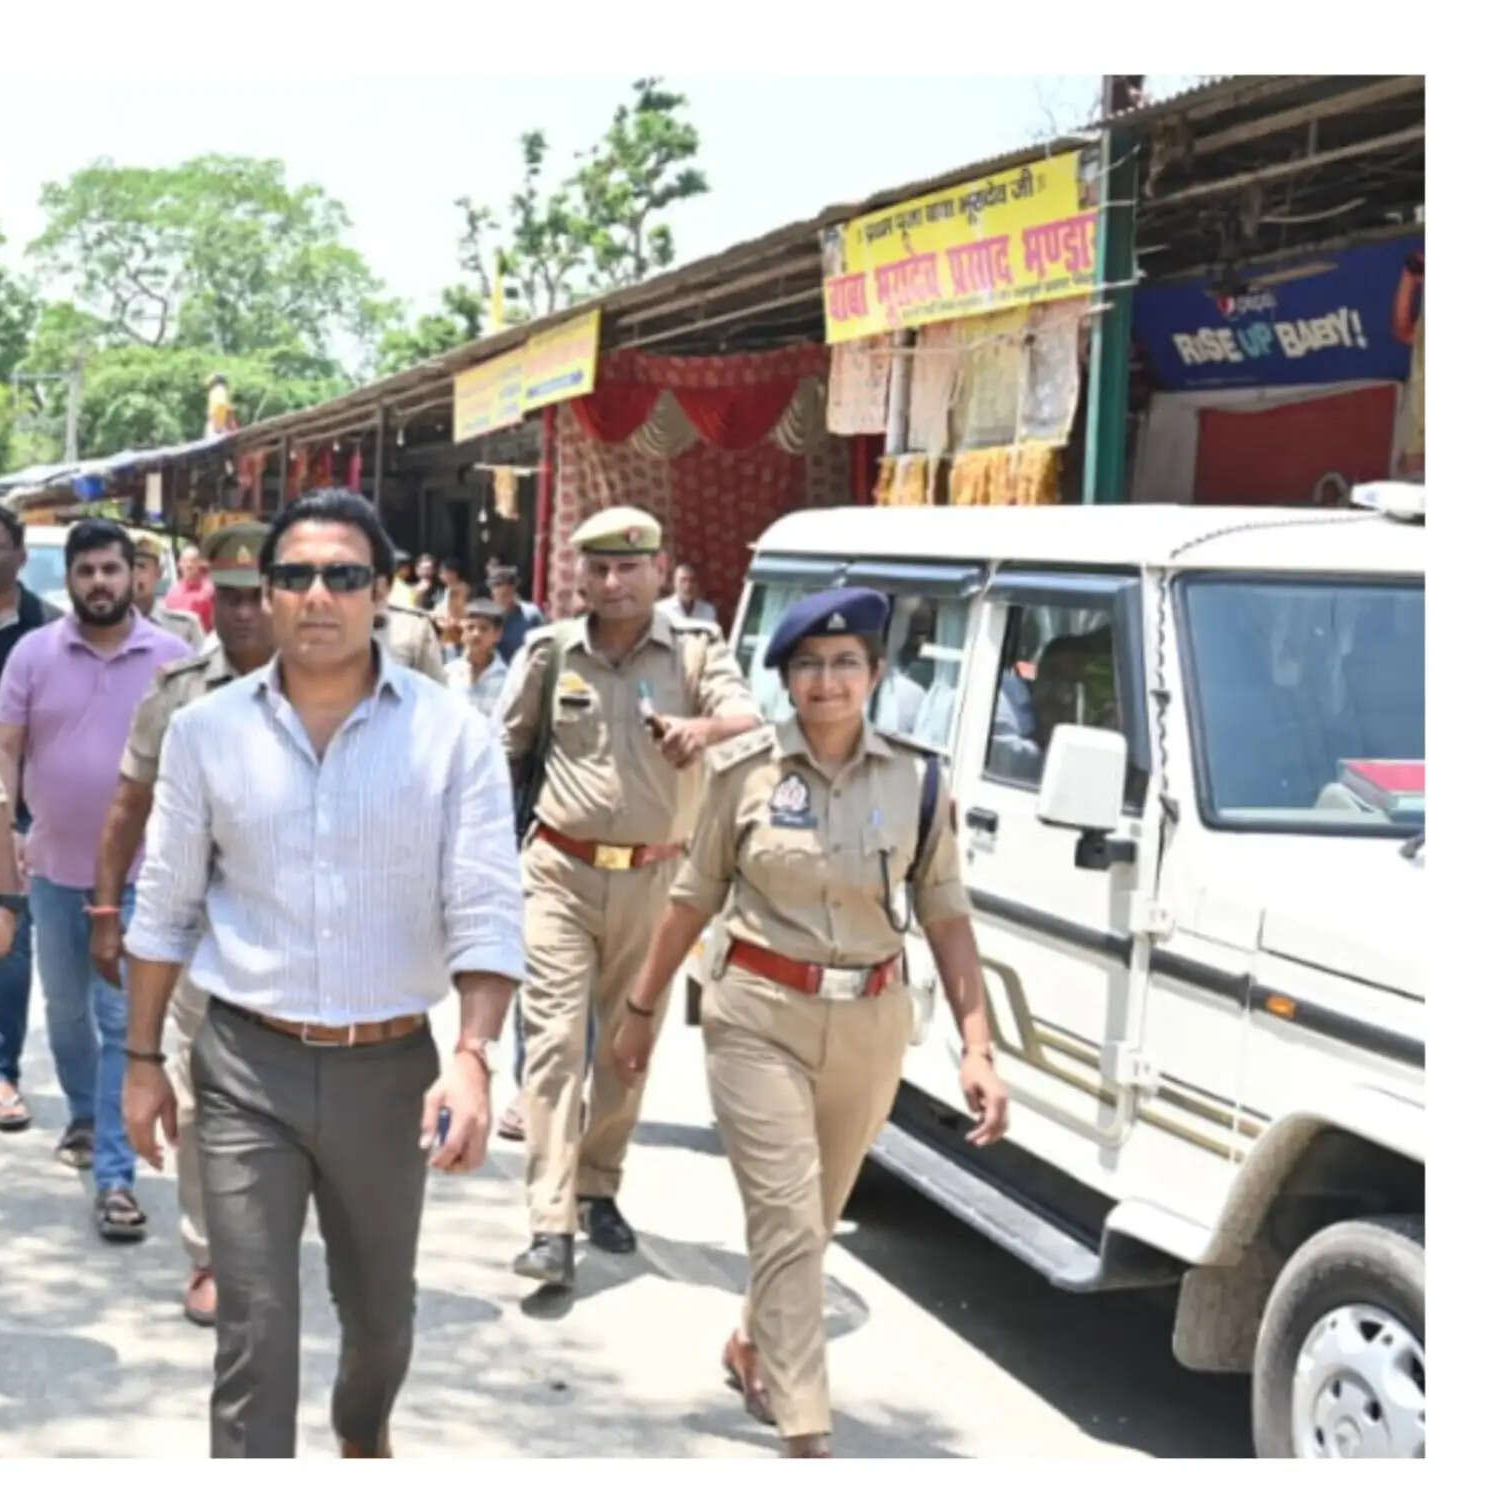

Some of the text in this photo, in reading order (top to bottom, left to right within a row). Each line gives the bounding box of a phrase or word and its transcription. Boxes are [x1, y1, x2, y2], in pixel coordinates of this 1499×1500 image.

[1021, 211, 1097, 279] भण्डा
[1172, 306, 1368, 366] RISE UP BABY!
